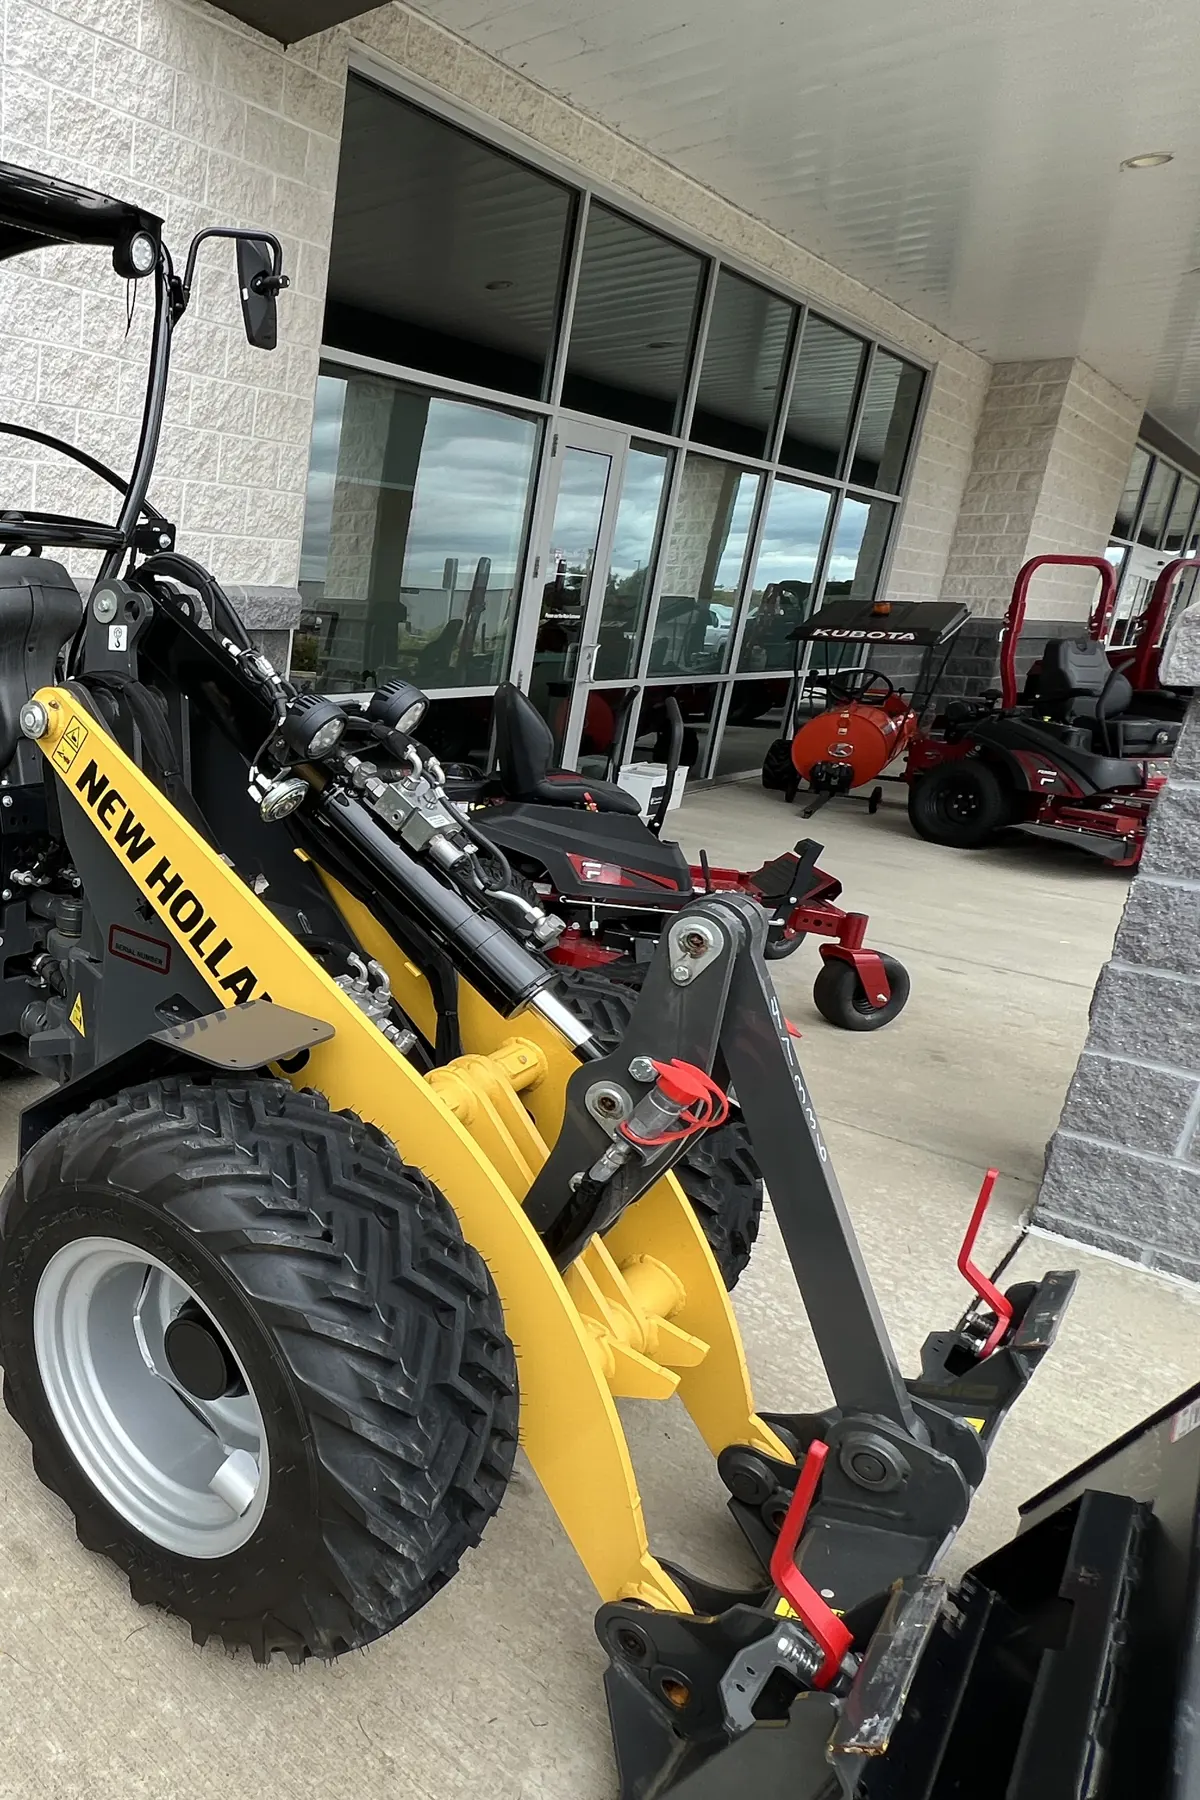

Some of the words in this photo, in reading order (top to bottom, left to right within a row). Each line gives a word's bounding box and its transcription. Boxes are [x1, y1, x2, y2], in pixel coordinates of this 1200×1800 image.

[812, 628, 916, 641] KUBOTA
[75, 759, 156, 864] NEW
[145, 856, 273, 1006] HOLLA
[115, 942, 136, 956] SERIAL
[137, 950, 163, 965] NUMBER
